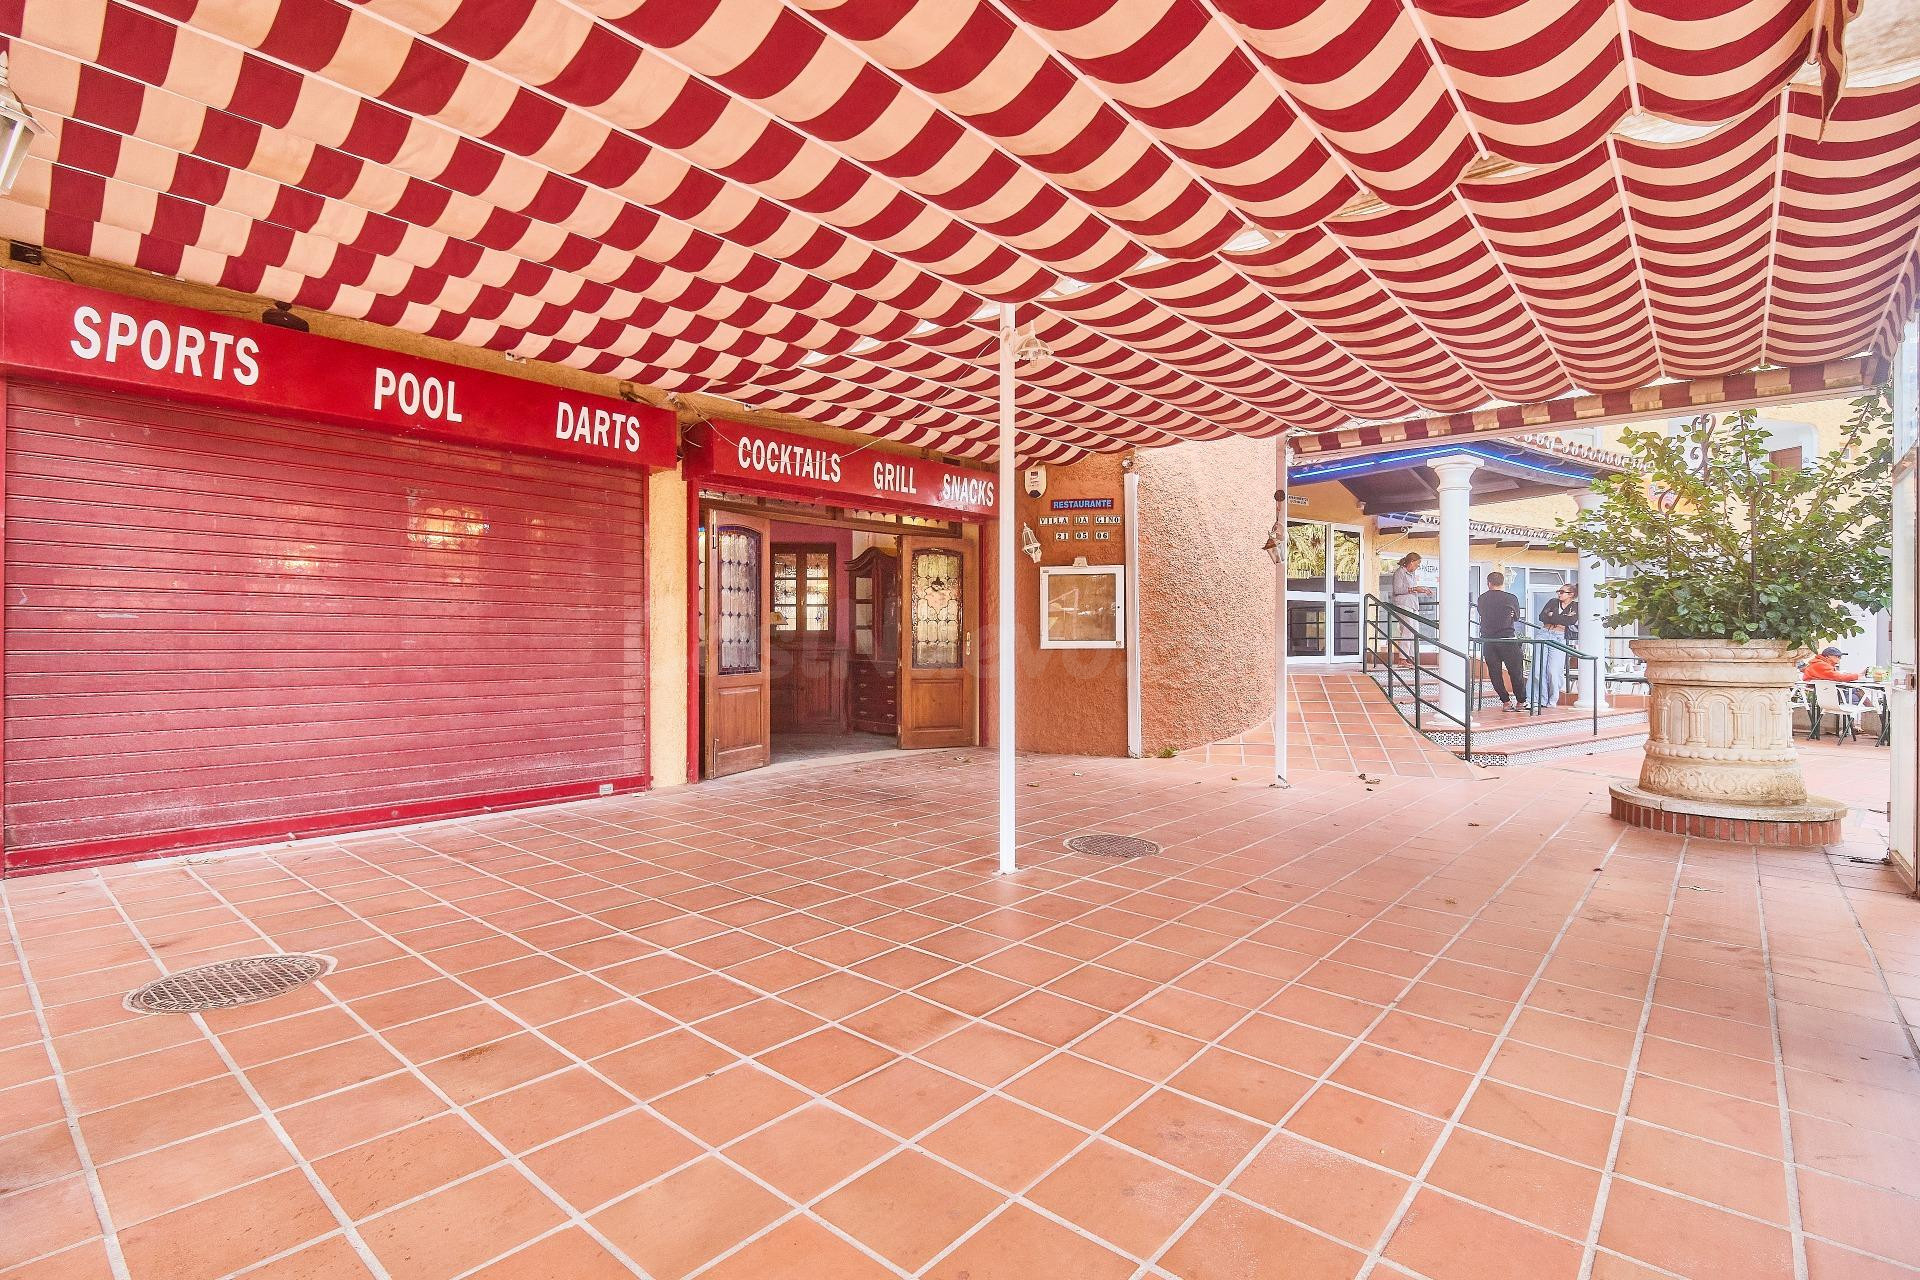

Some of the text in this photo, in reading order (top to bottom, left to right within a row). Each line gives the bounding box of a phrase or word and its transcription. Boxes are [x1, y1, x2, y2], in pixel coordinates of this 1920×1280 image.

[70, 305, 640, 453] SPORTS POOL DARTS
[738, 436, 994, 507] COCKTAILS GRILL SNACKS
[1053, 499, 1112, 509] RESTAURANTE
[1040, 516, 1121, 525] VILLA DA GINO
[1056, 532, 1109, 540] 21 05 06
